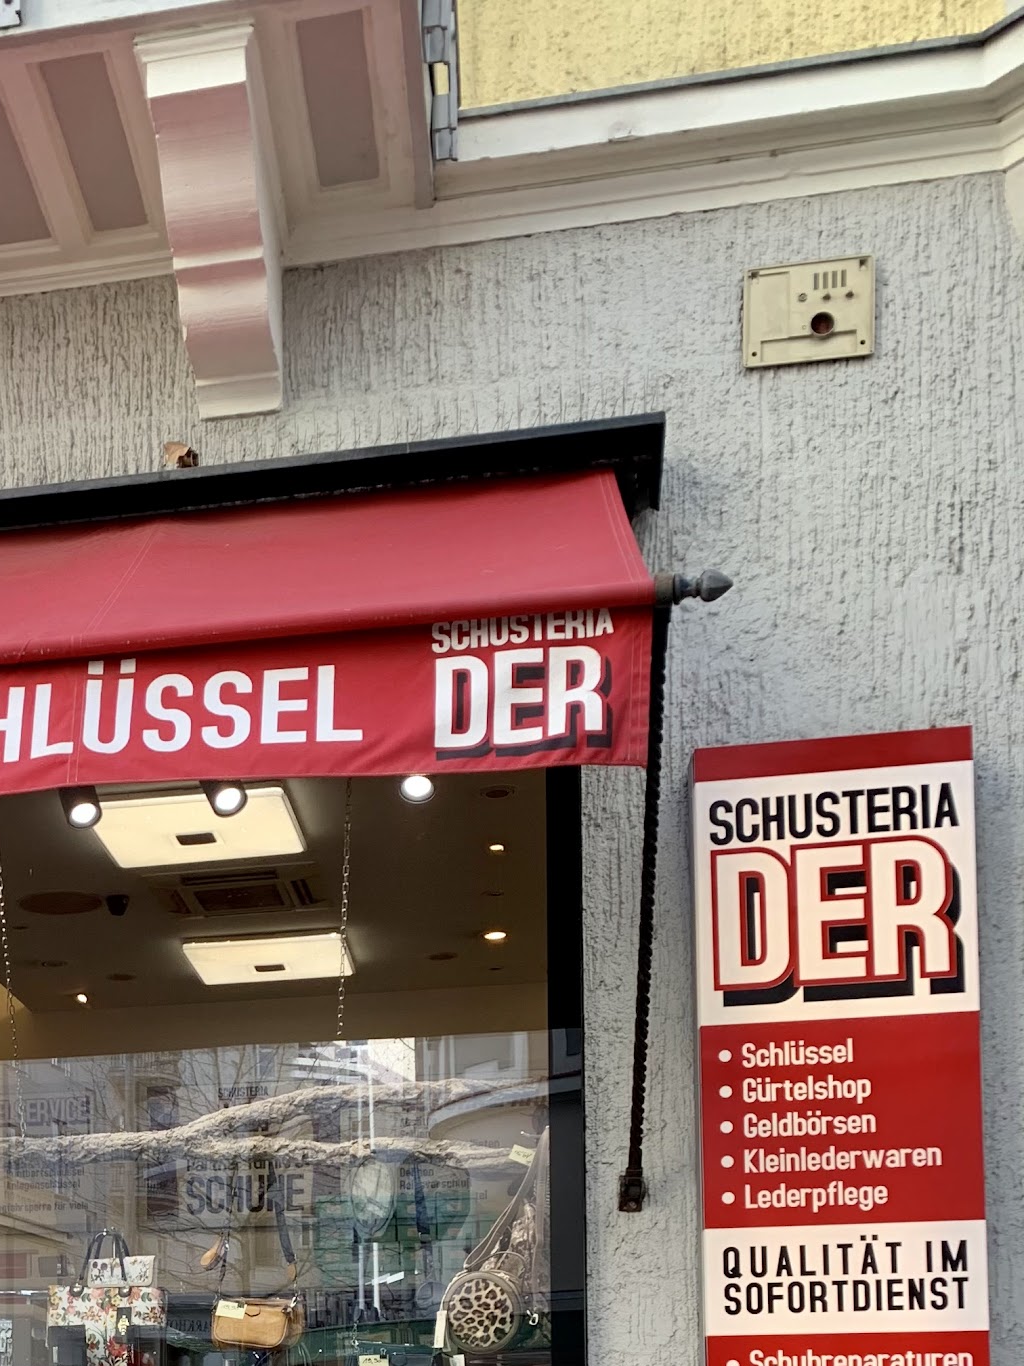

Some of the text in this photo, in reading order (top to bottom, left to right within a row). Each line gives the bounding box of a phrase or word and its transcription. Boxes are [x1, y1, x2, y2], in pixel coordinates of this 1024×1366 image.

[431, 607, 615, 653] SCHUSTERIA
[434, 645, 613, 761] DER
[709, 782, 960, 846] SCHUSTERIA
[711, 835, 964, 1003] DER
[742, 1037, 854, 1069] Schlüssel
[743, 1075, 872, 1104] Gürtelshop
[743, 1110, 877, 1139] Geldbörsen
[744, 1144, 943, 1174] Kleinlederwaren
[744, 1181, 889, 1213] Lederpflege
[722, 1235, 969, 1280] QUALITÄT IM
[723, 1277, 970, 1316] SOFORTDIENST
